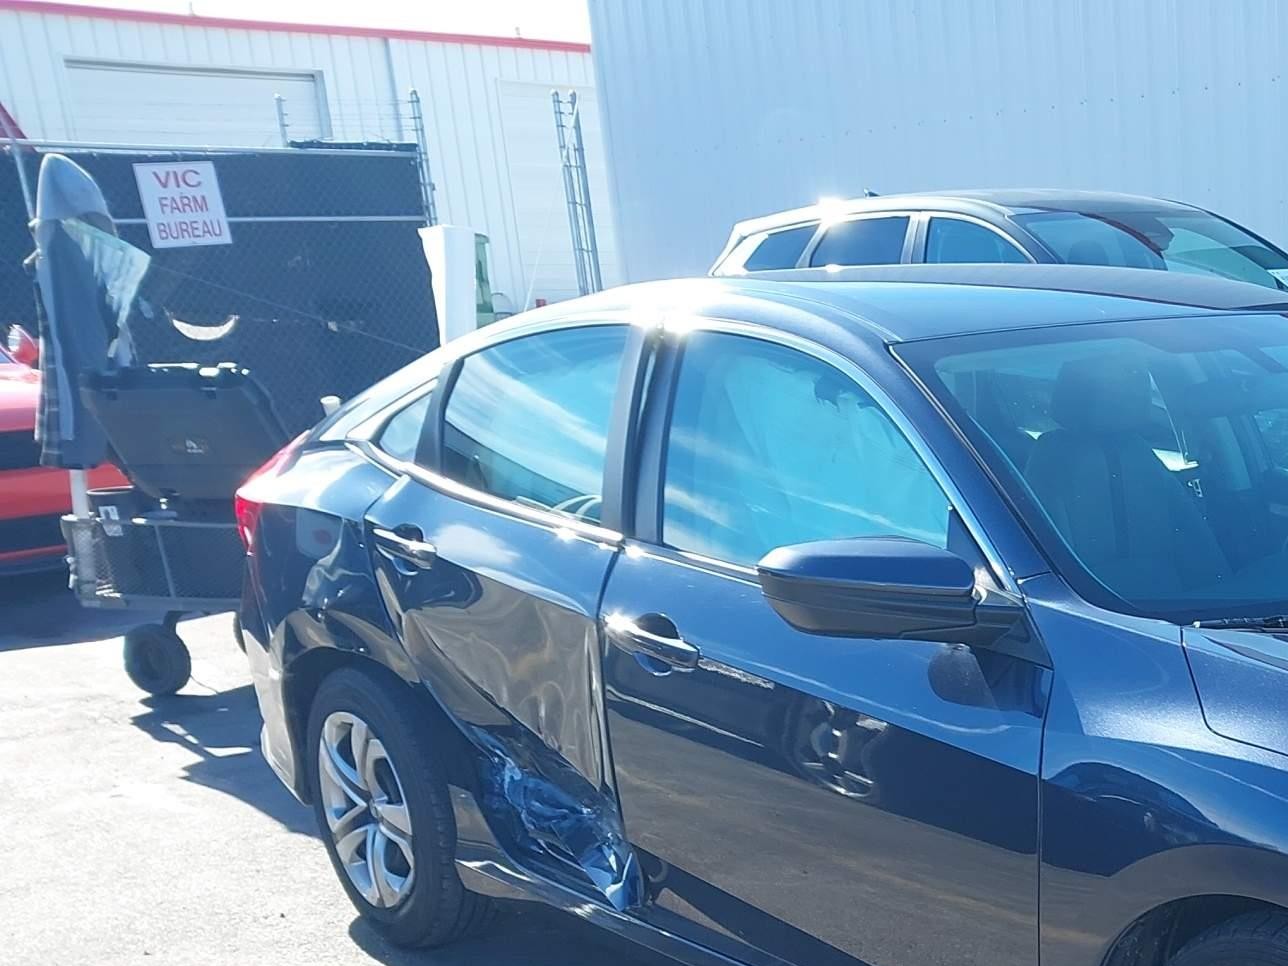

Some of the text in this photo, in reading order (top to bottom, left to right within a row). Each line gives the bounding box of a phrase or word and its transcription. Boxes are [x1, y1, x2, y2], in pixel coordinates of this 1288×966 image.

[152, 169, 202, 189] VIC
[158, 195, 209, 214] FARM
[156, 219, 223, 240] BUREAU
